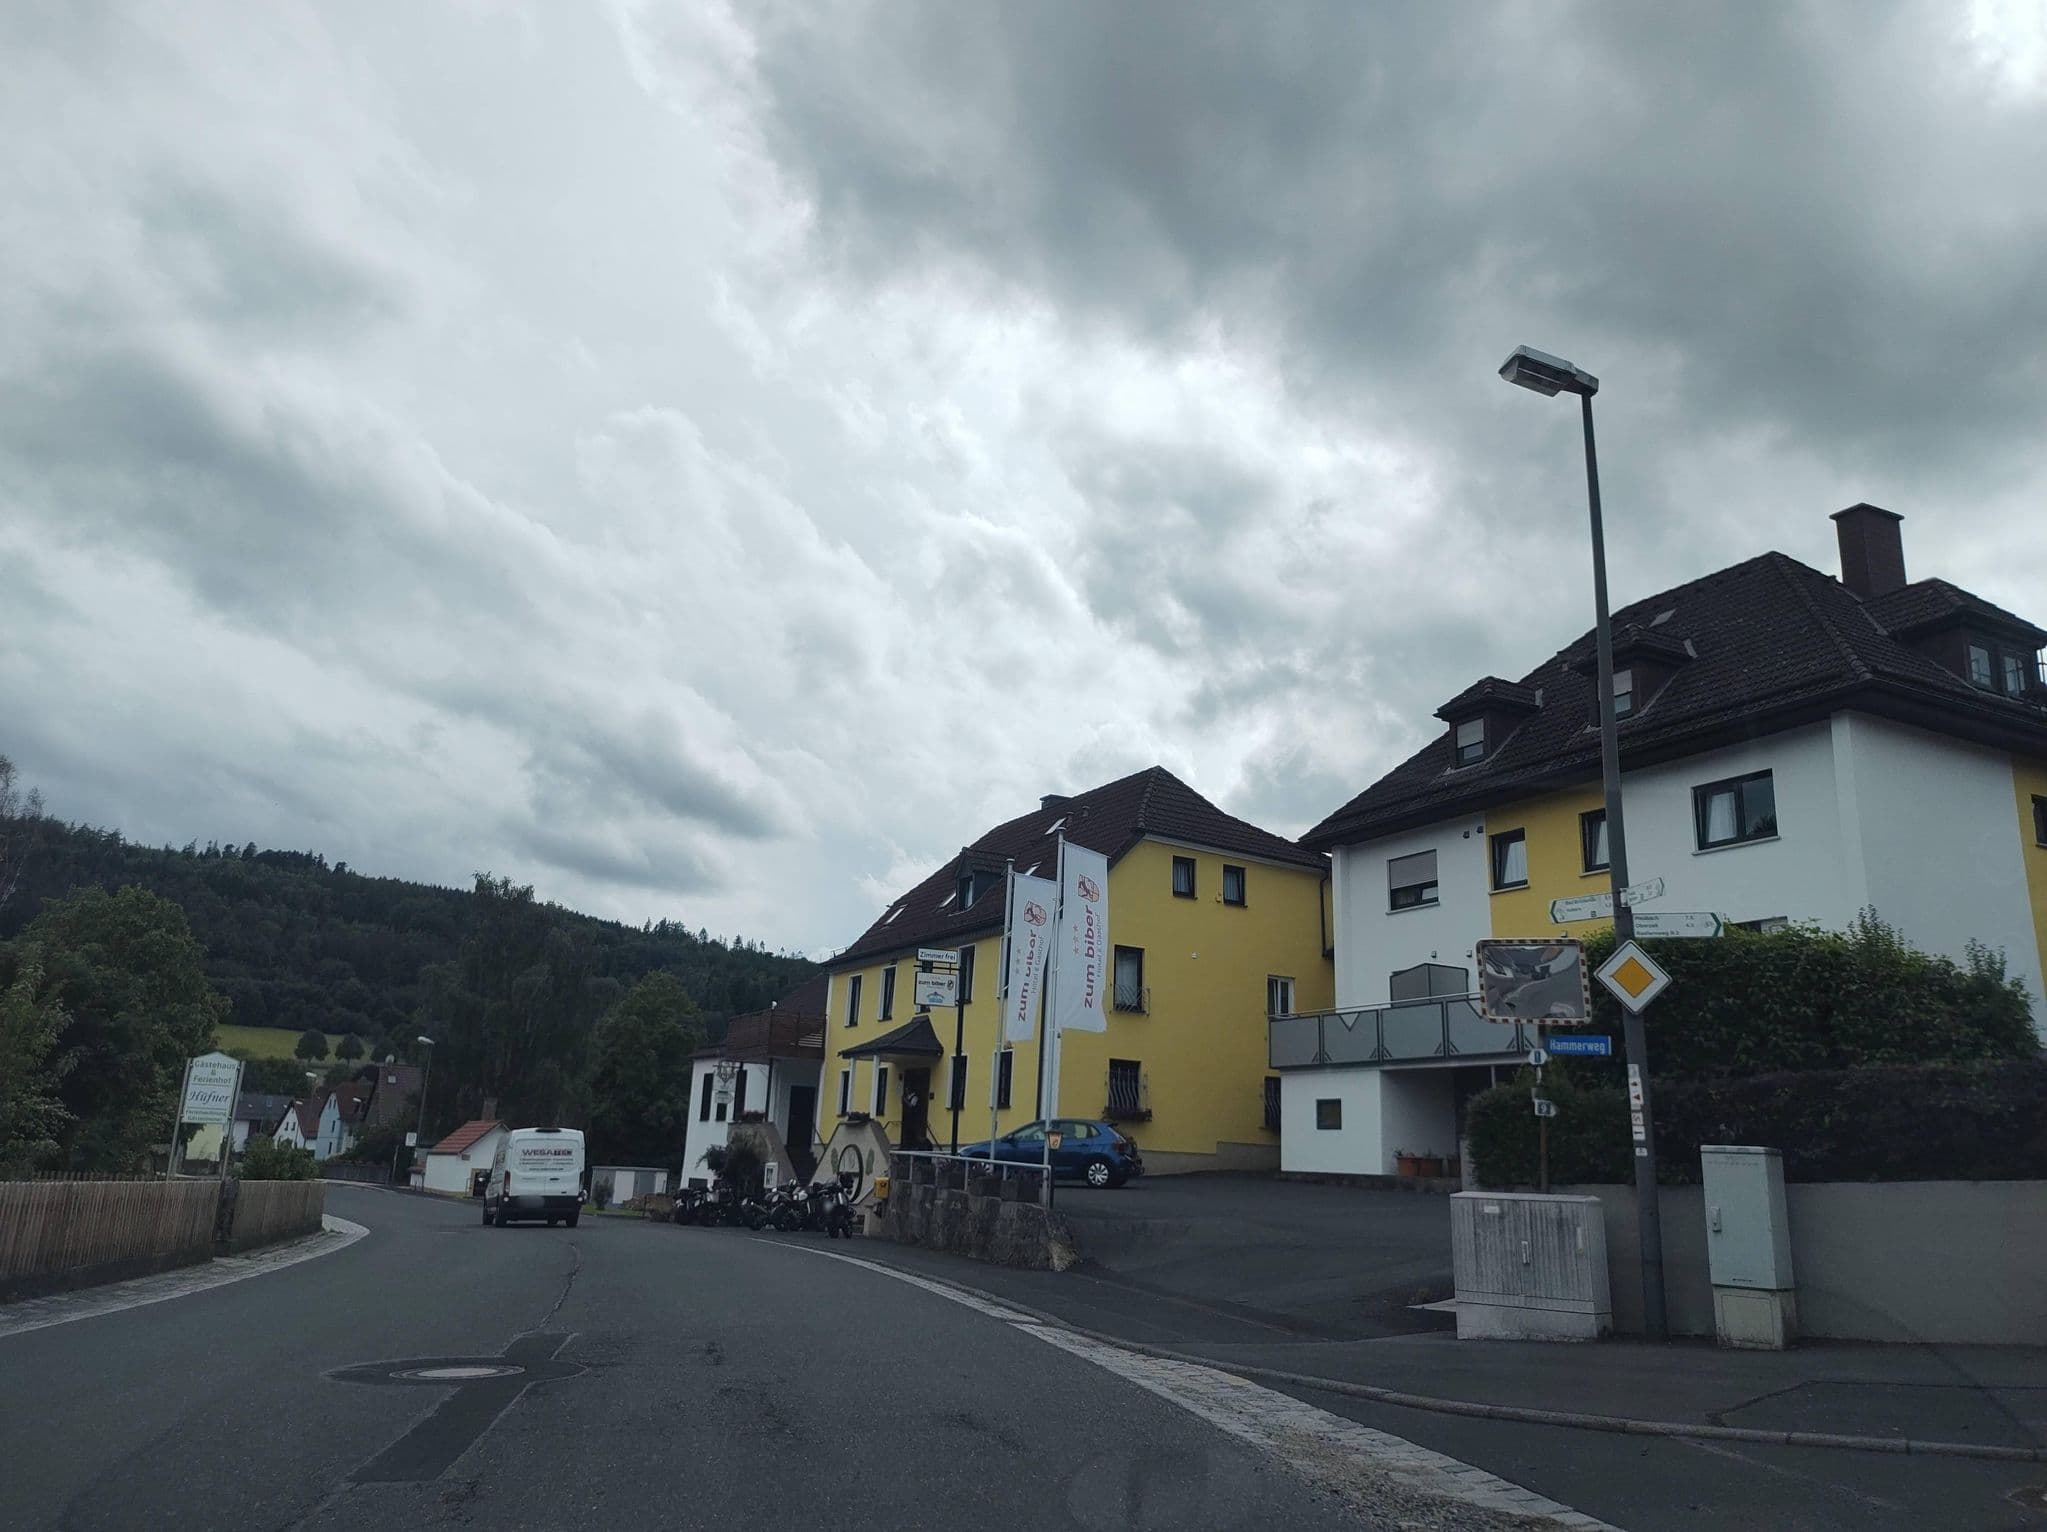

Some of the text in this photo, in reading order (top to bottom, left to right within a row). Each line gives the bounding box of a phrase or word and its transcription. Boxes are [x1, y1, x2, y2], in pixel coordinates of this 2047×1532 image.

[1085, 905, 1095, 1008] zum biber
[1018, 982, 1030, 1022] zum
[1550, 1042, 1606, 1055] Hammerweg
[194, 1060, 237, 1070] Gästehaus
[193, 1075, 232, 1084] Ferienhof
[1541, 1103, 1547, 1113] 9
